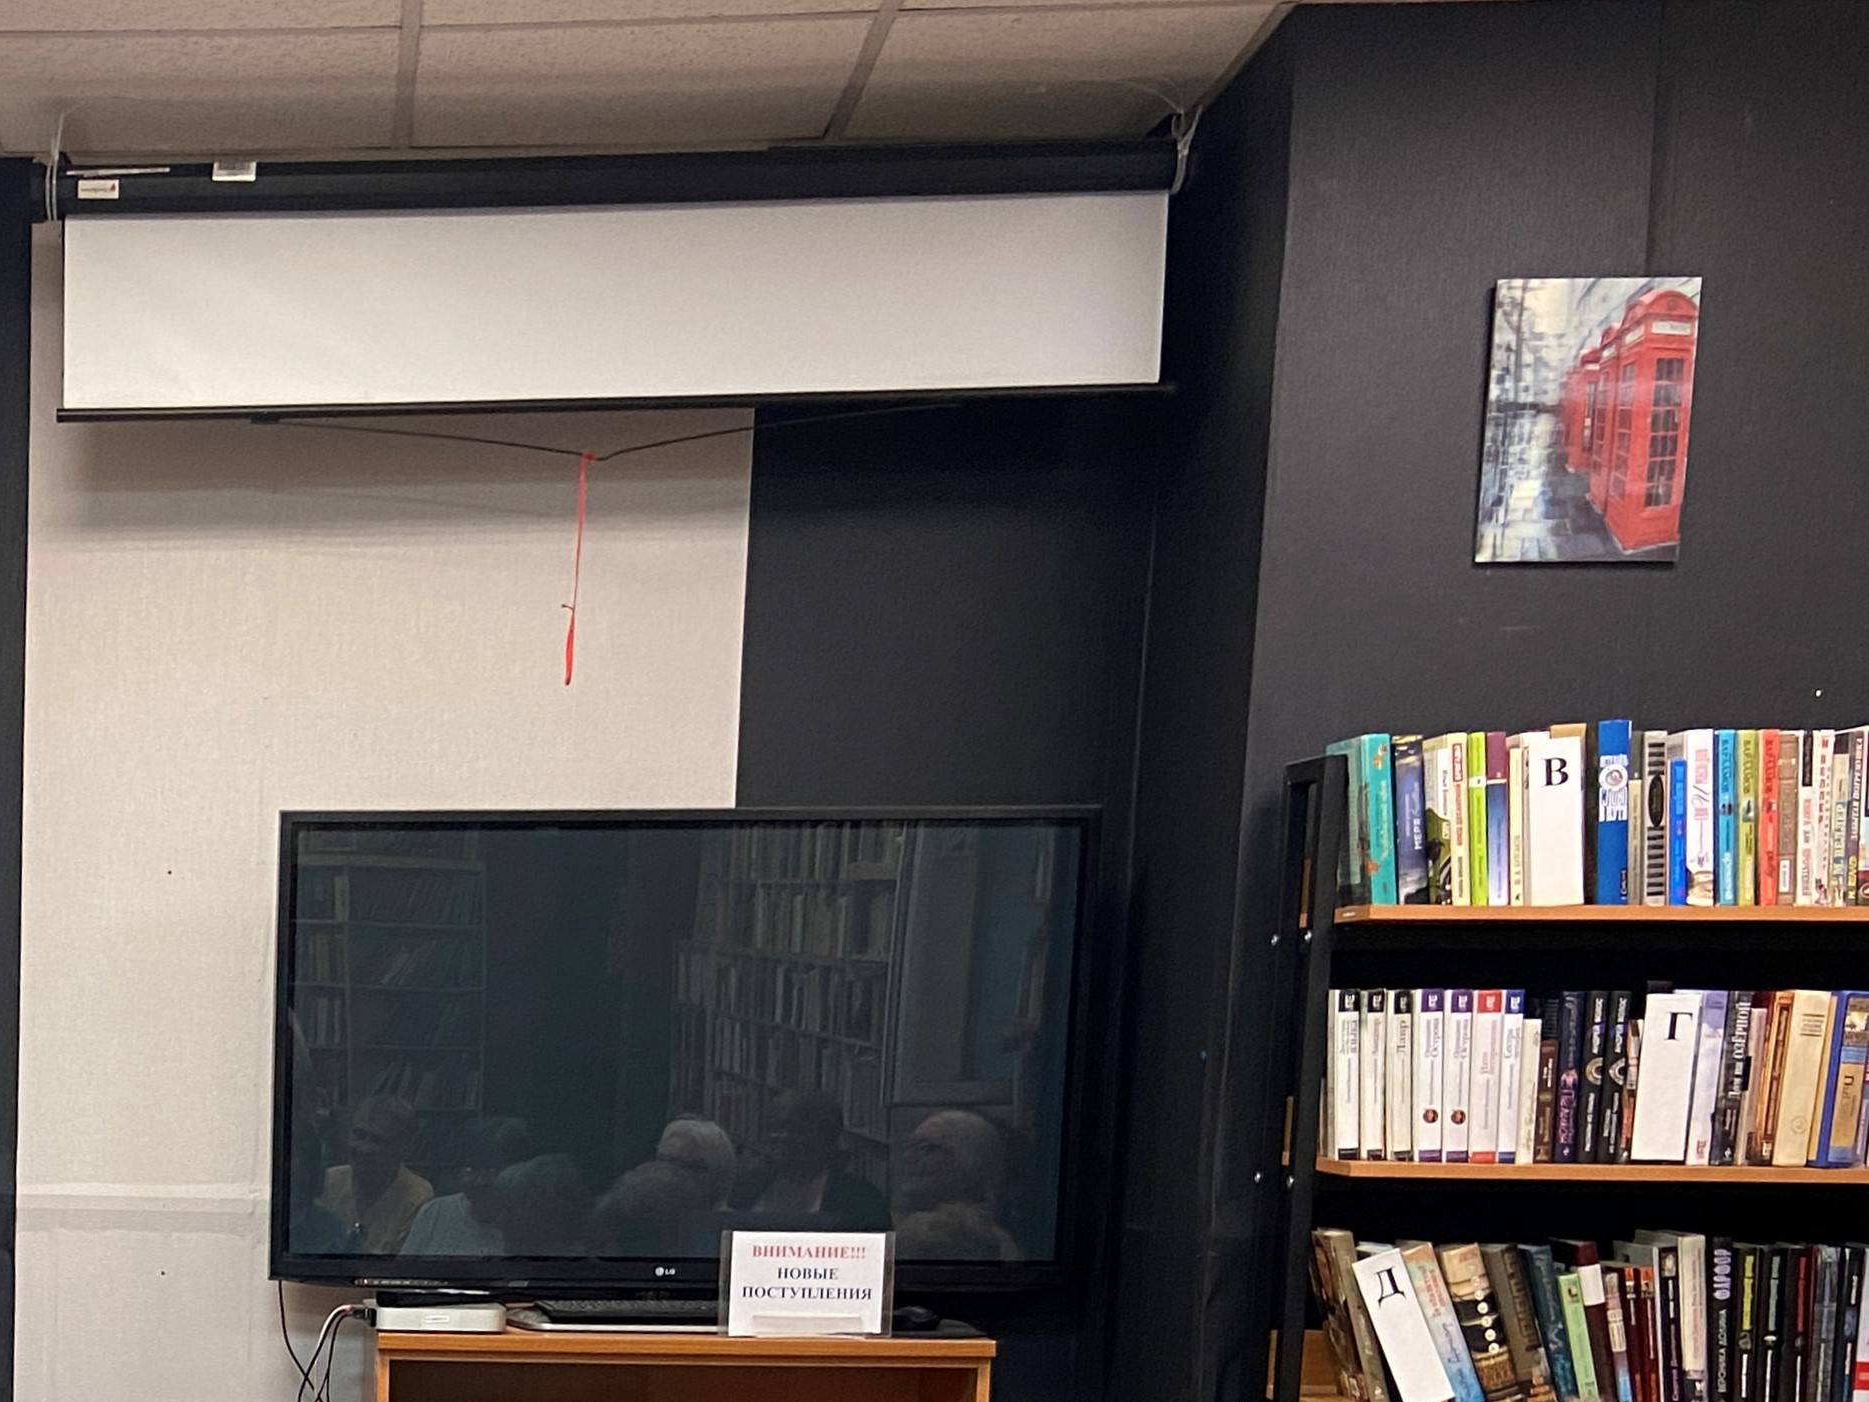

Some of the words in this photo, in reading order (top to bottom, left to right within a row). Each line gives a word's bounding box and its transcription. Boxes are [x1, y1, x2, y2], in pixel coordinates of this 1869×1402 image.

[1542, 757, 1570, 787] В
[1664, 1012, 1692, 1041] Г
[1732, 1002, 1750, 1059] ОЗЁРНОЙ
[753, 1245, 866, 1259] ВНИМАНИЕ!!!
[778, 1267, 838, 1280] НОВЫЕ
[1378, 1267, 1405, 1304] Д
[742, 1286, 872, 1300] ПОСТУПЛЕНИЯ
[1718, 1348, 1727, 1393] ВЕРОНИКА
